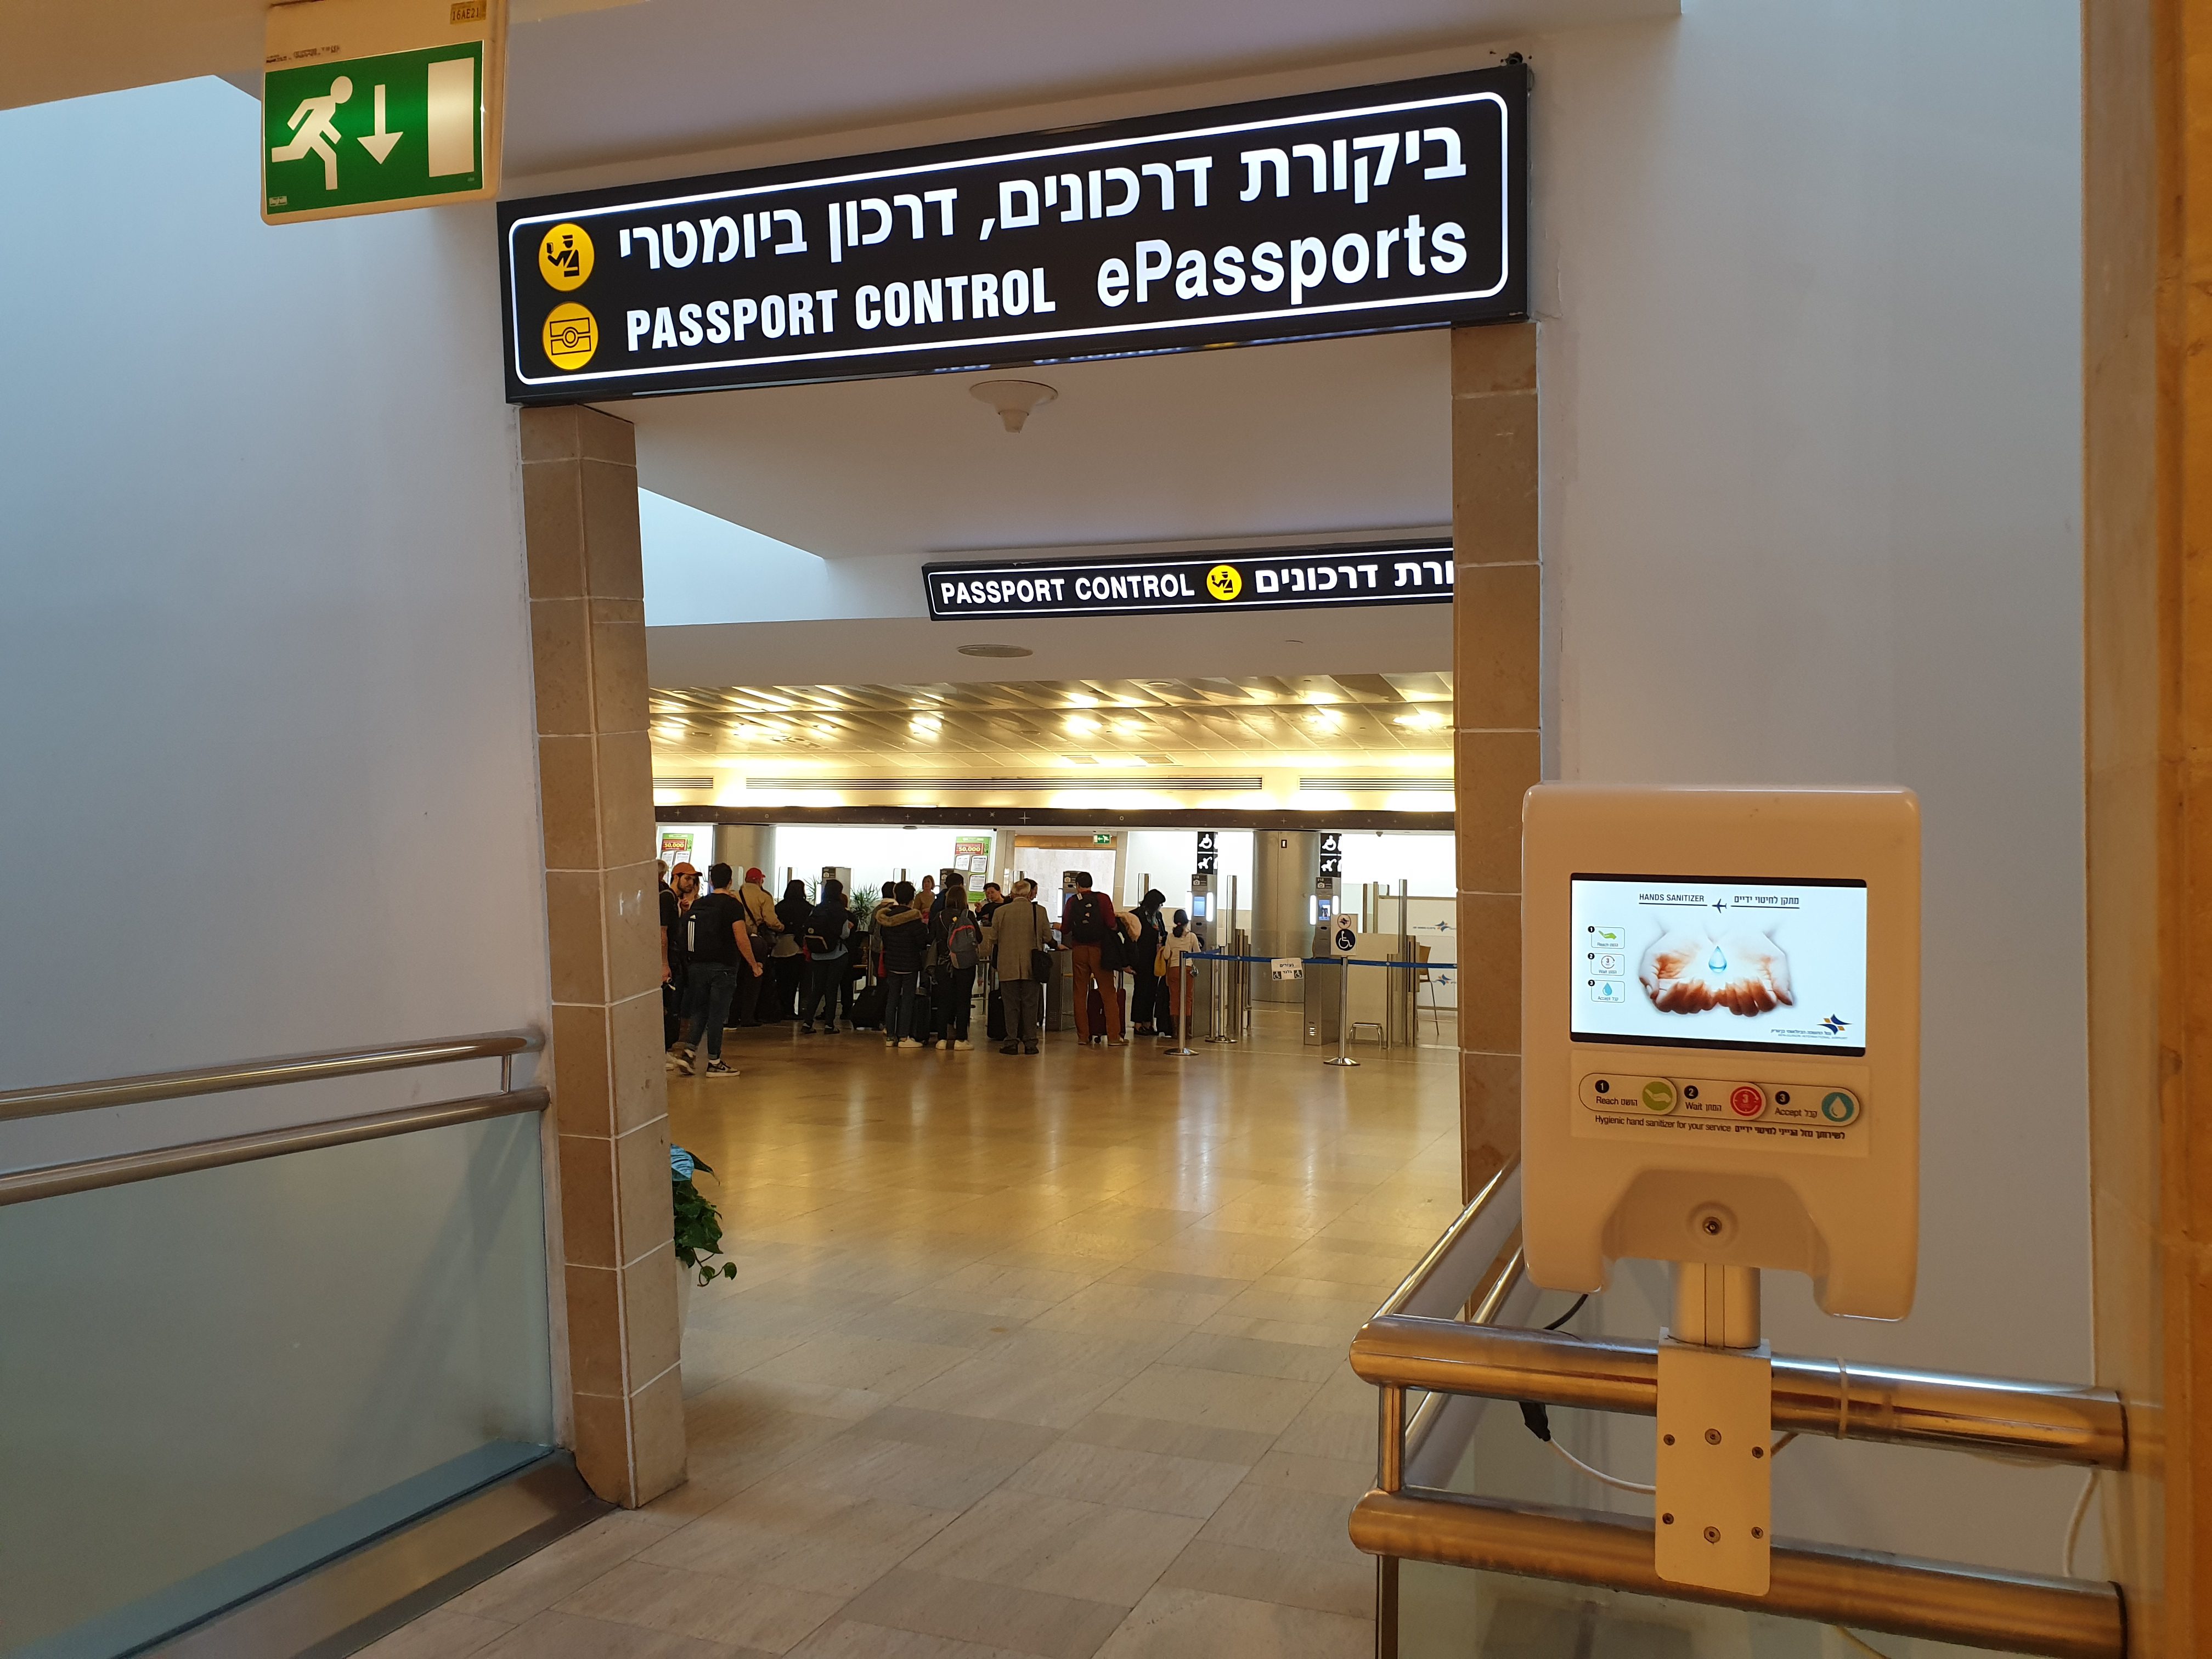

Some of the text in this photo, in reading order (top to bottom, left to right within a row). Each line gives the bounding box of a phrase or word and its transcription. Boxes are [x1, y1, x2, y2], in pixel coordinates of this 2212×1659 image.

[452, 7, 479, 21] 16AE21
[618, 126, 1467, 270] ביקורת דרכונים, דרכון ביומטרי
[626, 213, 1468, 352] PASSPORT CONTROL ePassports
[1255, 560, 1454, 594] ורת דרכונים
[941, 573, 1195, 605] PASSPORT CONTROL
[1666, 894, 1705, 902] SANITIZER
[1755, 895, 1778, 904] לחיטוי
[1781, 897, 1799, 905] מתקן
[1600, 1082, 1604, 1091] 1
[1688, 1088, 1694, 1096] 2
[1596, 1096, 1619, 1105] Reach
[1621, 1098, 1638, 1106] הושט
[1742, 1094, 1749, 1103] 3
[1779, 1093, 1786, 1102] 3
[1685, 1102, 1702, 1110] Wait
[1775, 1107, 1802, 1118] Accept
[1595, 1115, 1624, 1125] Hygienic
[1627, 1117, 1644, 1126] hand
[1645, 1119, 1675, 1128] sanitizer
[1677, 1120, 1687, 1129] for
[1706, 1124, 1732, 1132] service
